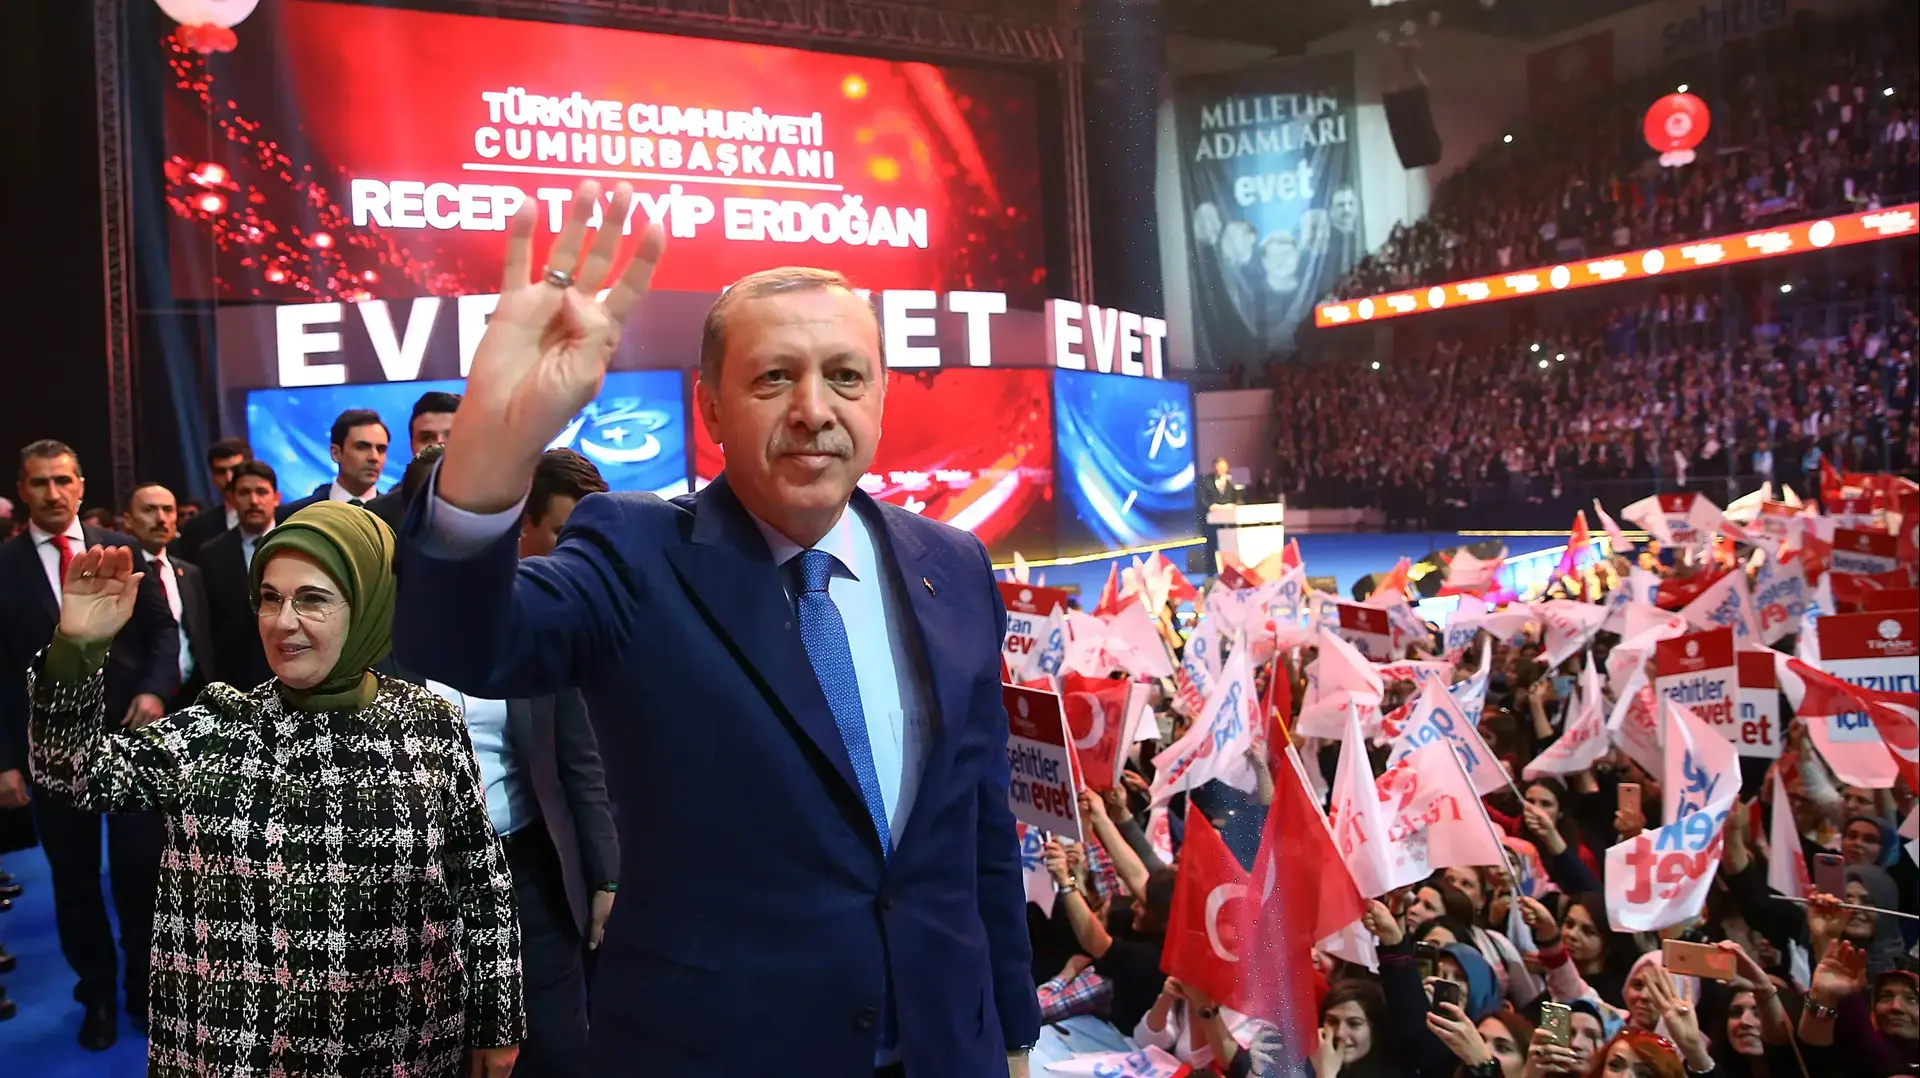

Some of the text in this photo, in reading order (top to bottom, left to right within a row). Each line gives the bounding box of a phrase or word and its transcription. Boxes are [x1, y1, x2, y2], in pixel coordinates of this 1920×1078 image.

[482, 86, 823, 147] TÜRKİYE CUMHURİYETİ
[1195, 115, 1348, 162] ADAMLARI
[474, 127, 834, 179] CUMHURBAŞKANI
[1234, 158, 1315, 207] evet
[351, 178, 527, 231] RECEP
[723, 194, 929, 249] ERDOĞAN
[1053, 298, 1167, 379] EVET
[1031, 781, 1074, 821] evet
